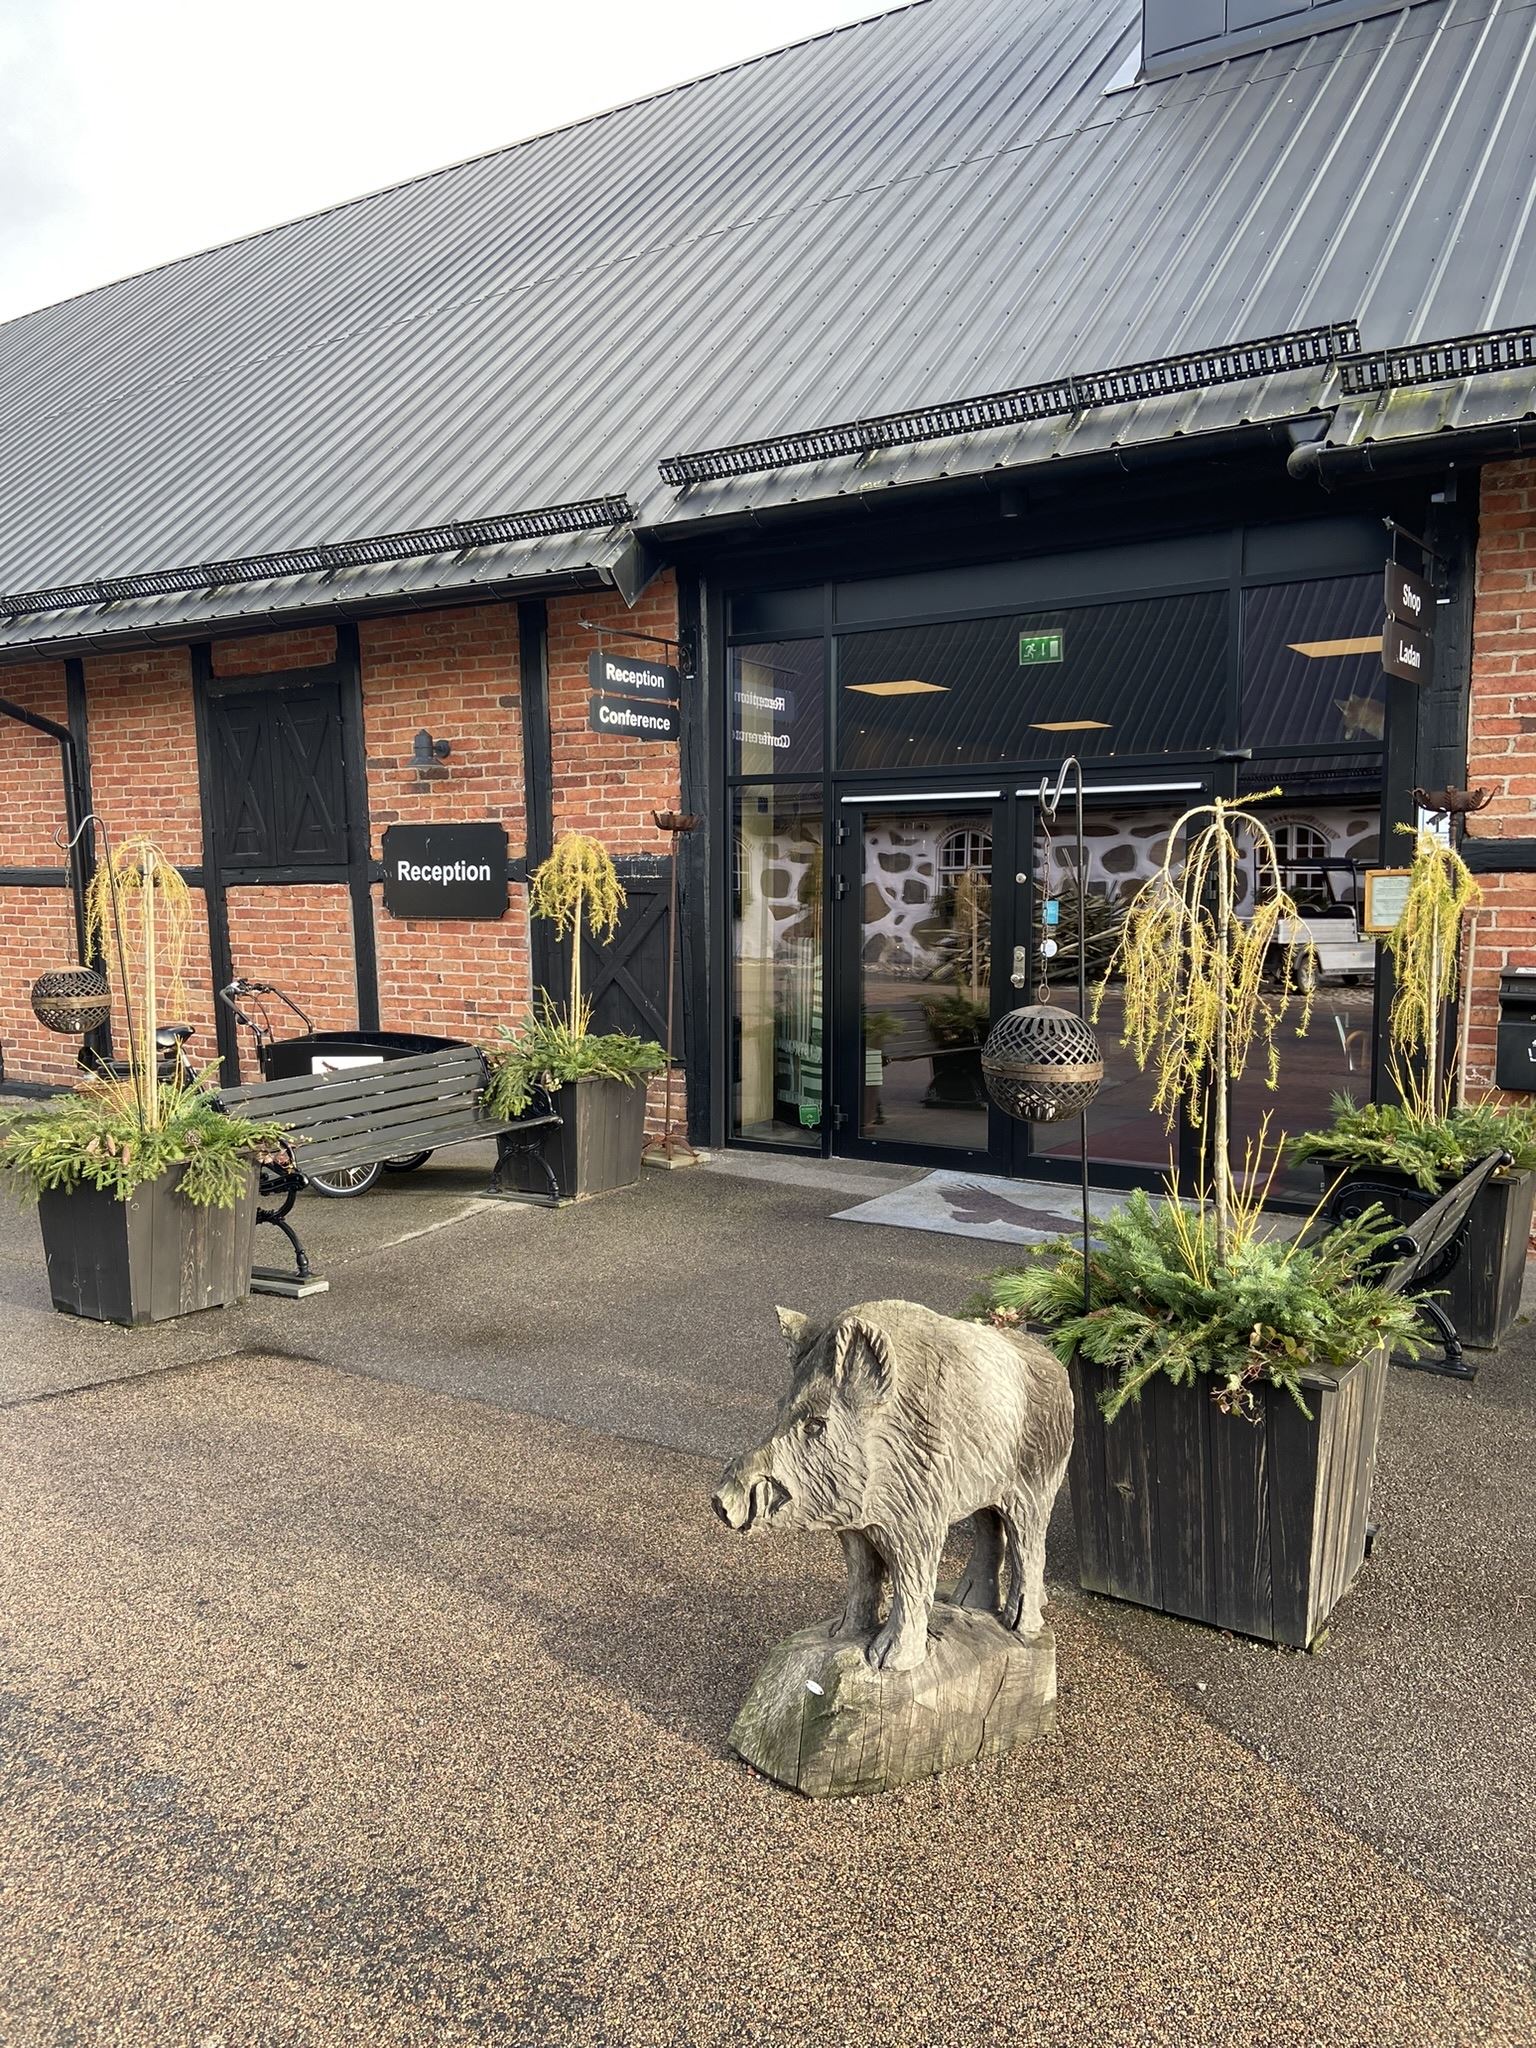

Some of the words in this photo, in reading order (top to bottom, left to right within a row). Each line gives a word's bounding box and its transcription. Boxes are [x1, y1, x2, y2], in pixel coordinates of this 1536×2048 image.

[1402, 583, 1421, 616] Shop
[1399, 640, 1421, 668] Ladan
[606, 663, 664, 688] Reception
[600, 705, 671, 731] Conference
[398, 860, 491, 886] Reception
